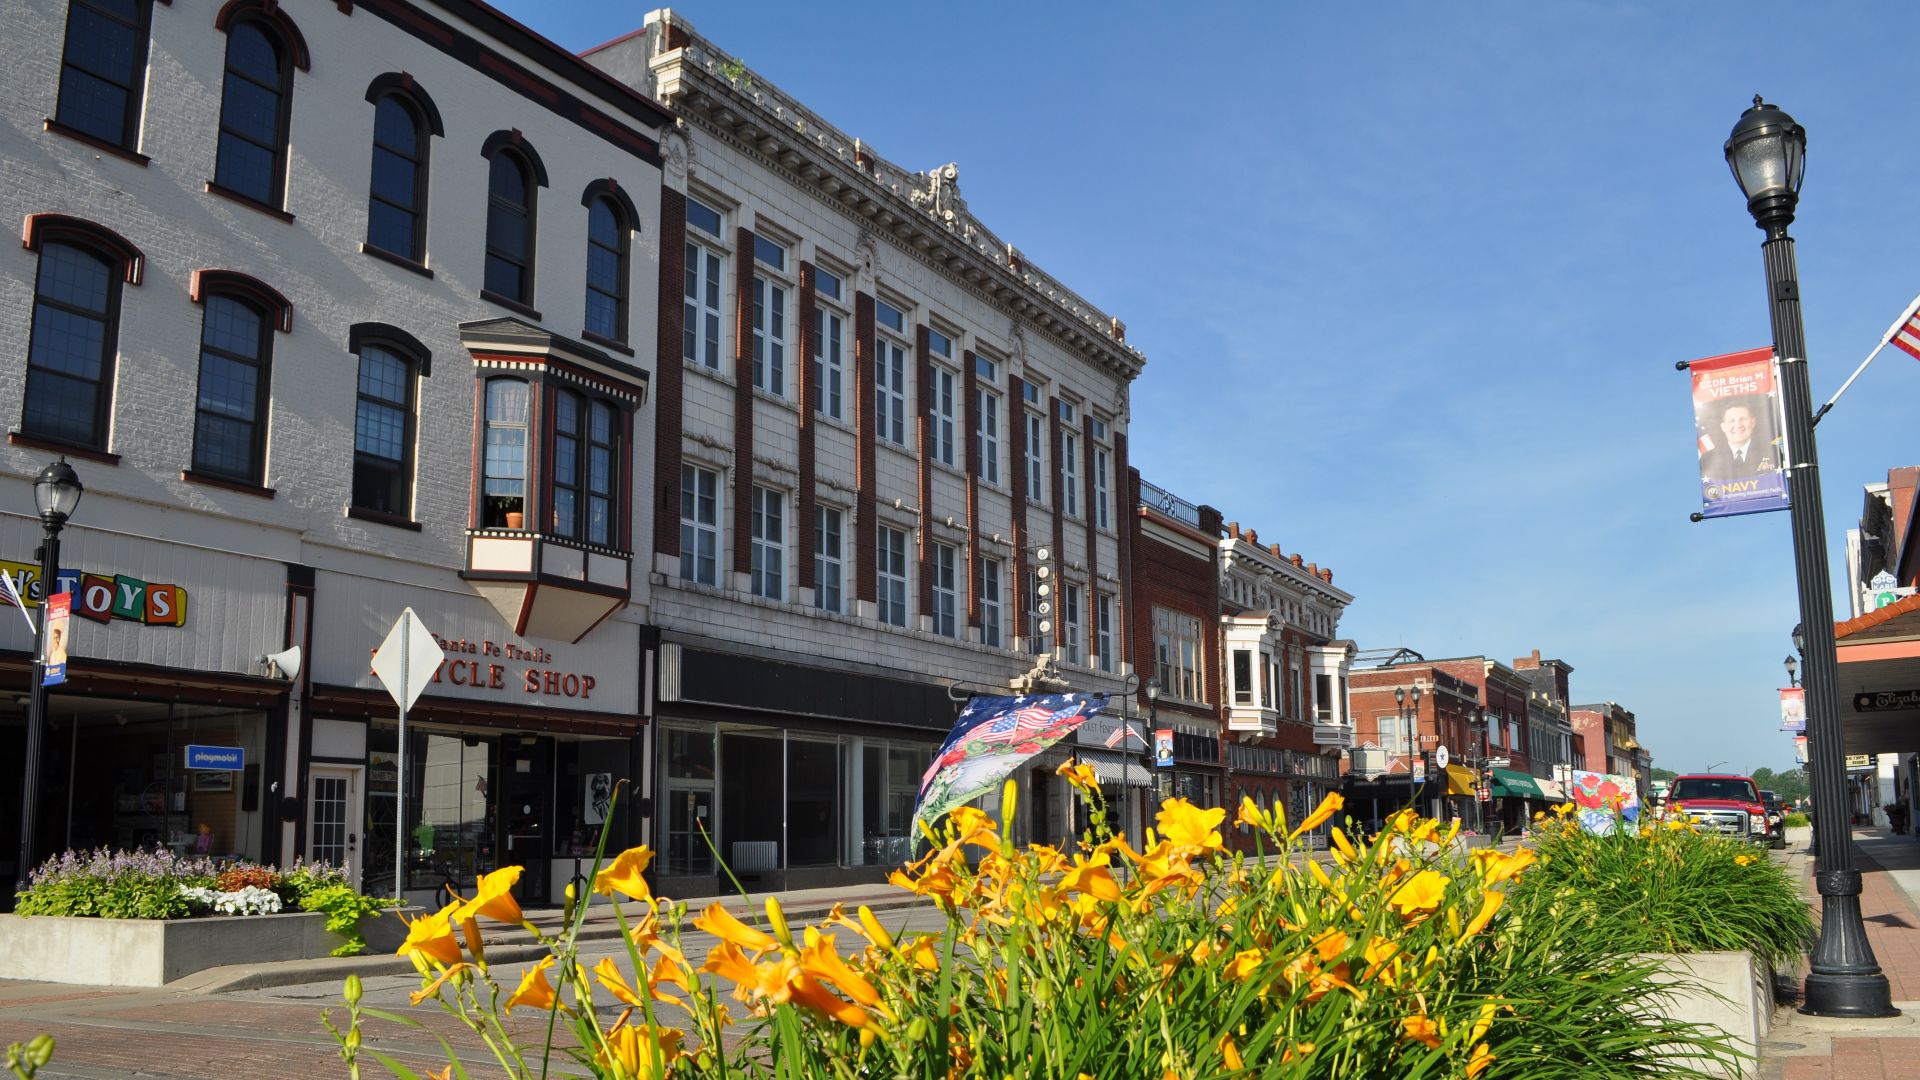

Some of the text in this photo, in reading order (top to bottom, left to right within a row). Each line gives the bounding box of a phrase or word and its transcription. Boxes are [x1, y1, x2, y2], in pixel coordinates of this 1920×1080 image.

[1729, 376, 1752, 385] Brian
[1711, 381, 1757, 398] VIETHS
[1722, 480, 1759, 493] NAVY
[57, 577, 170, 618] TOYS
[483, 640, 501, 658] Fe
[505, 643, 552, 664] Trails
[524, 668, 597, 699] SHOP
[195, 752, 238, 763] playmobil
